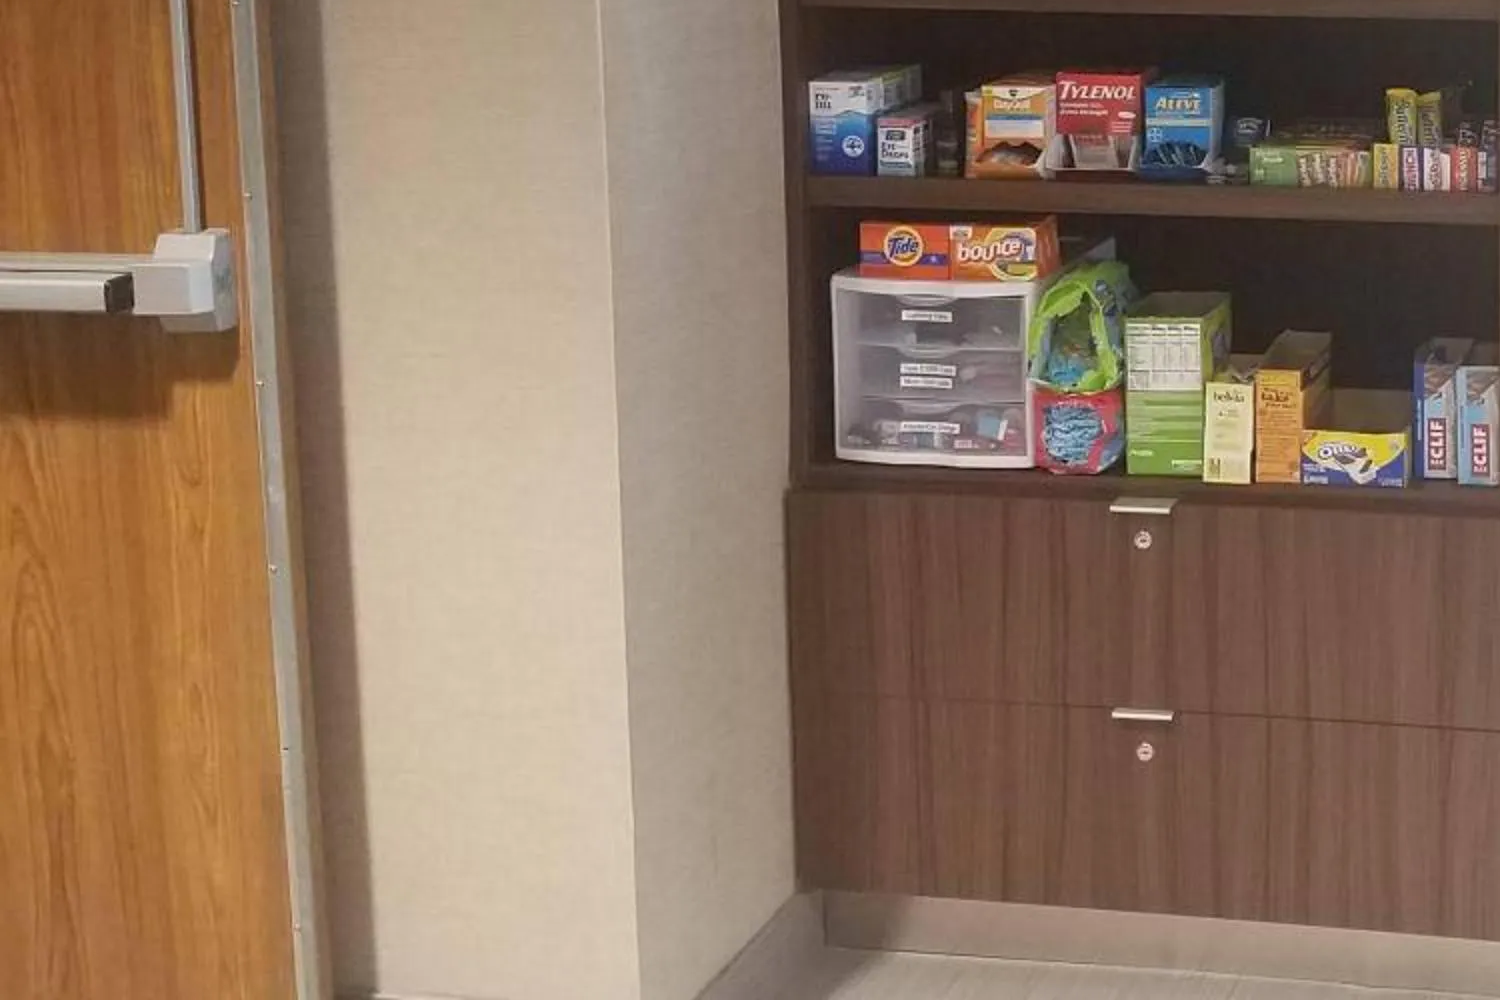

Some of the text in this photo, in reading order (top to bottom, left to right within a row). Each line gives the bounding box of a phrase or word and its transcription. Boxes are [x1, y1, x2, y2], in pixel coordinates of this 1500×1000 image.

[1059, 80, 1137, 101] TYLENOL
[886, 234, 922, 258] Tide
[957, 238, 1023, 262] bounce
